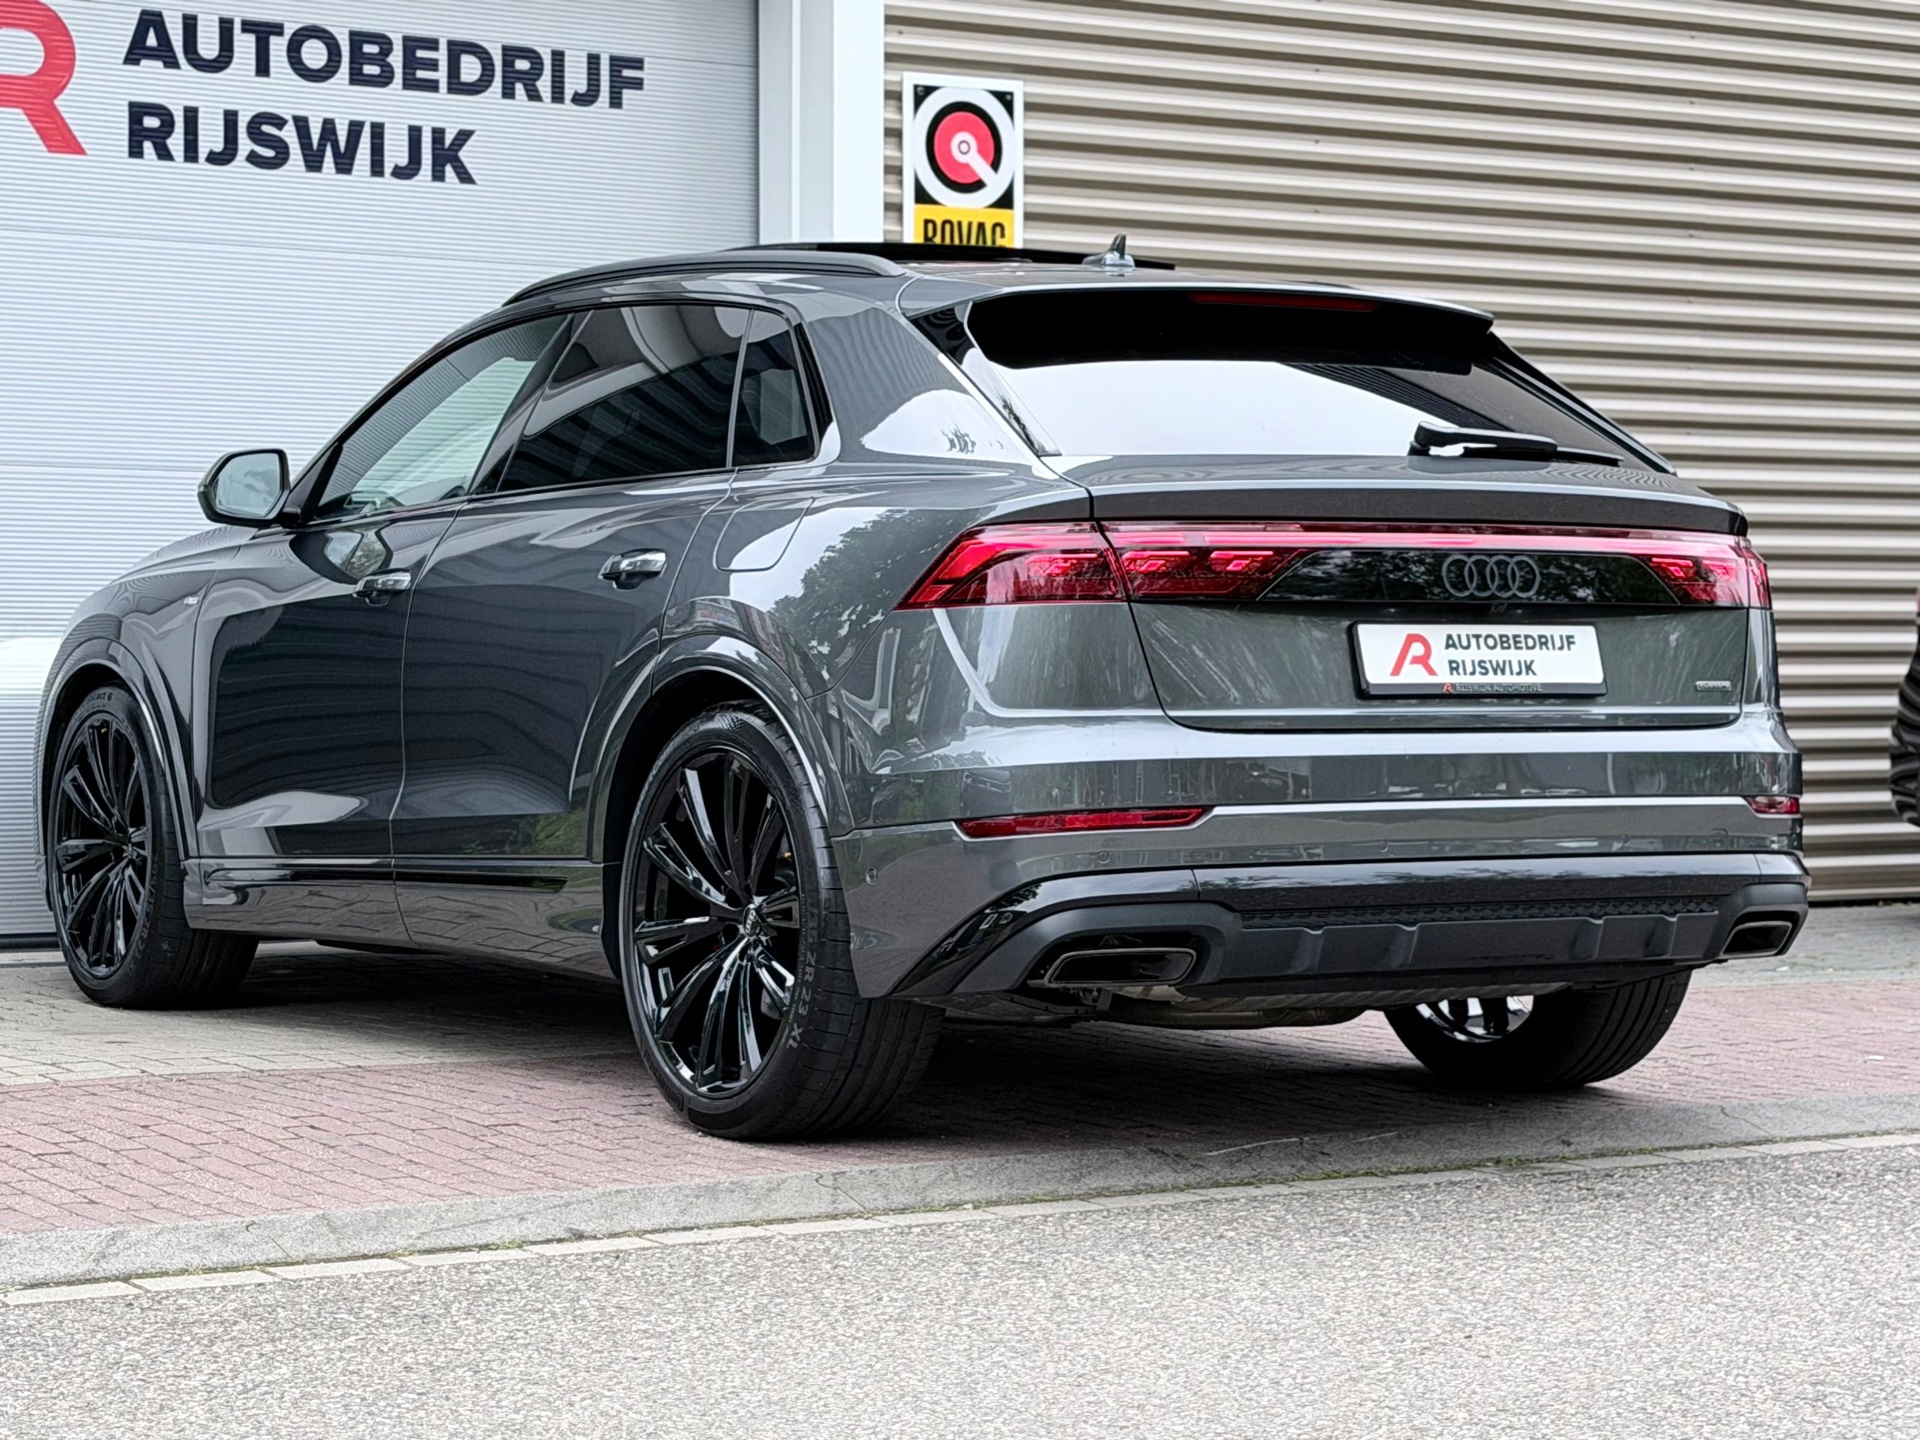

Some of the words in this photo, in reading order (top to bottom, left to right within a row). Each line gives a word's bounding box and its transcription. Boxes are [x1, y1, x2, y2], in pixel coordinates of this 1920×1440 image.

[122, 9, 645, 109] AUTOBEDRIJF
[128, 100, 478, 185] RIJSWIJK
[1444, 633, 1576, 651] AUTOBEDRIJF
[1448, 659, 1538, 676] RIJSWIJK
[804, 951, 816, 982] ZR
[799, 986, 811, 1016] 23
[786, 1023, 803, 1049] XL
